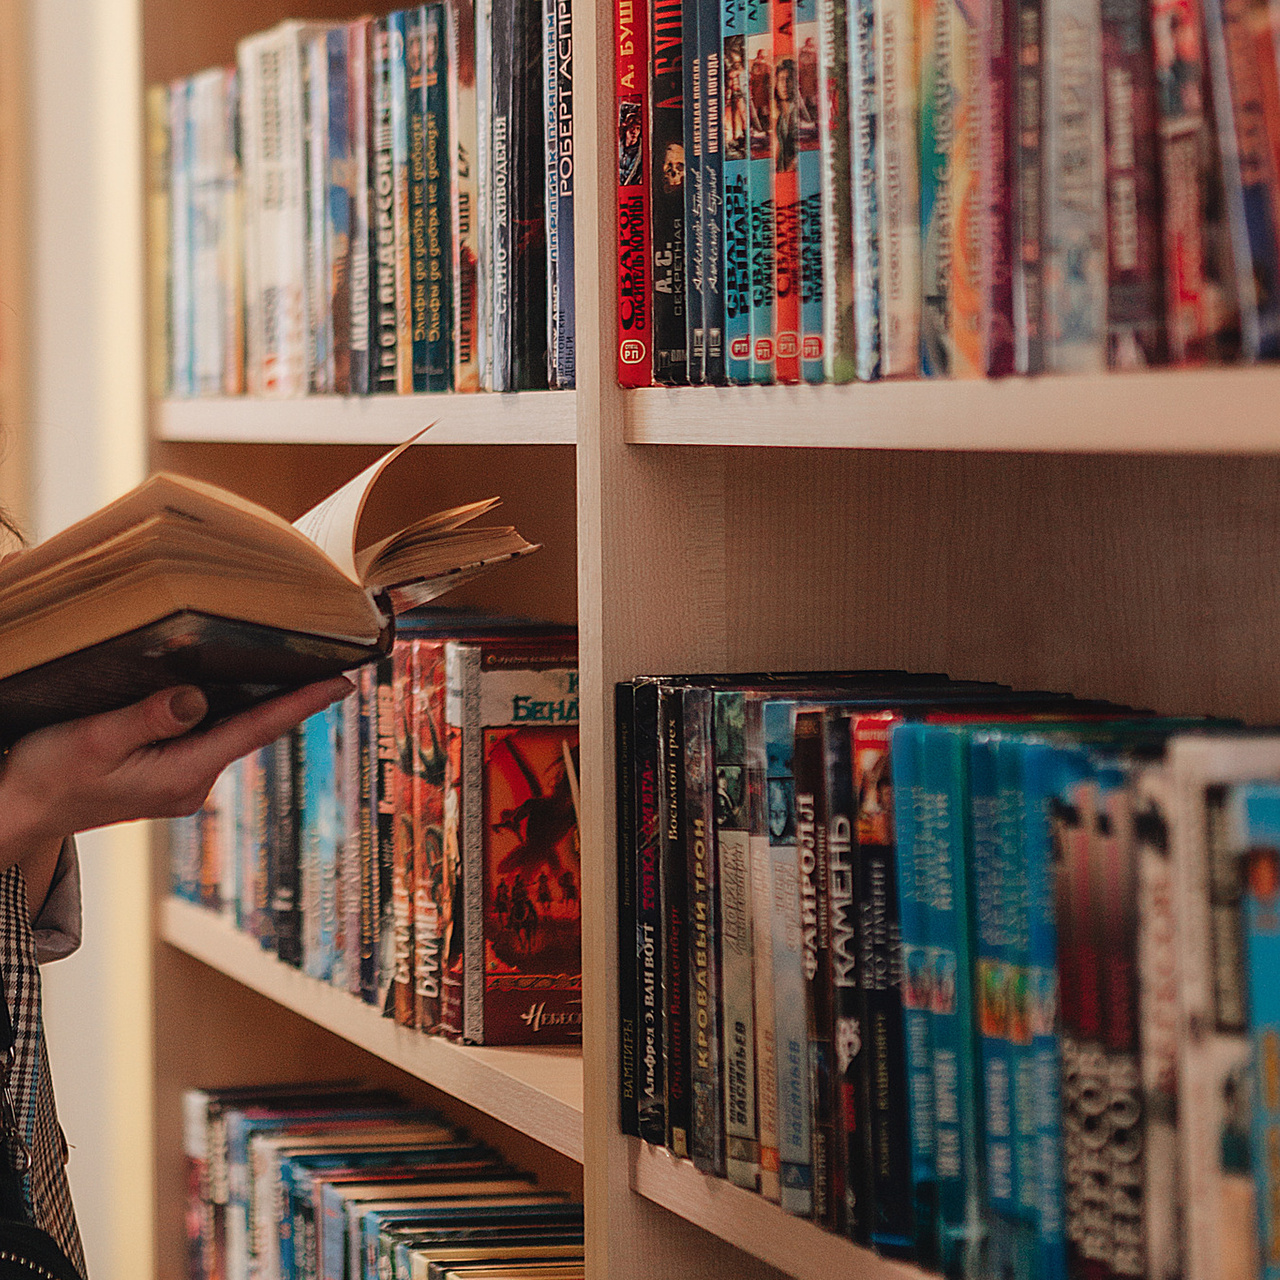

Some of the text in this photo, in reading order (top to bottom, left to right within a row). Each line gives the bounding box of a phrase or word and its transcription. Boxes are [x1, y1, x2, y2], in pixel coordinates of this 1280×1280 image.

[619, 63, 635, 89] А.
[707, 52, 719, 96] ПОГОДА
[558, 86, 572, 197] РОБЕРТ
[708, 98, 718, 154] НЕЛЕТНАЯ
[495, 115, 507, 228] ЖИВОДЕРНЯ
[496, 248, 507, 295] АРНО
[618, 197, 634, 331] СВАРОГ
[627, 195, 645, 331] СПАСИТЕЛЬ КОРОНЫ
[673, 218, 683, 316] СЕКРЕТНАЯ
[751, 200, 764, 308] СВАРОГ
[413, 284, 426, 341] Эльфы
[427, 284, 440, 342] Эльфы
[565, 335, 574, 378] ДЕНЬГИ
[624, 349, 639, 360] РП
[668, 719, 680, 757] грех
[666, 761, 678, 841] Восьмой
[642, 846, 655, 910] ТОЧКА
[829, 815, 856, 988] КАМЕНЬ
[643, 922, 655, 969] ВОГТ
[693, 819, 709, 1068] КРОВАВЫЙ ТРОН
[643, 971, 655, 1008] ВАН
[623, 1018, 634, 1099] ВАМПИРЫ
[643, 1027, 656, 1099] Альфред
[734, 1020, 747, 1126] ВАСИЛЬЕВ
